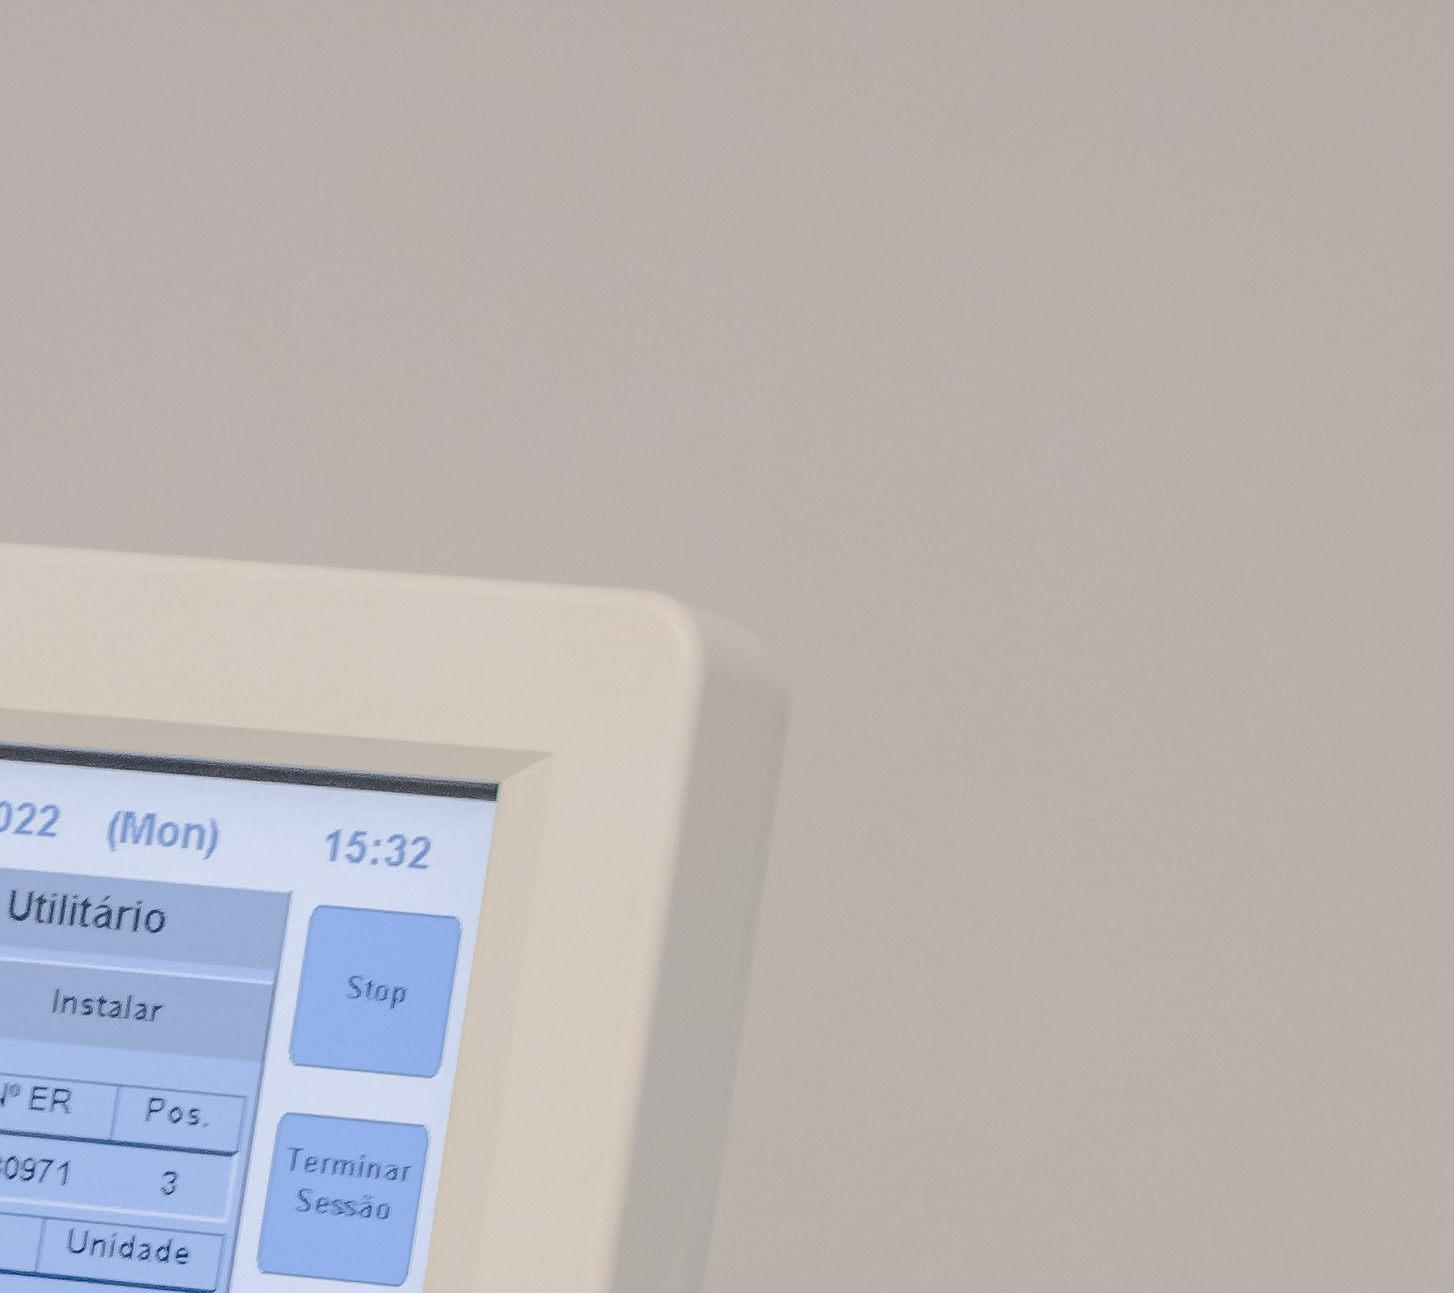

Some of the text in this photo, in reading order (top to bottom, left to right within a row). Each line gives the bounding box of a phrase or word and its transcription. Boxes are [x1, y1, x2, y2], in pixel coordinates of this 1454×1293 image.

[105, 808, 221, 861] (Mon)
[323, 828, 433, 872] 15:32
[8, 888, 168, 936] Utilitário
[51, 986, 165, 1025] Instalar
[344, 974, 409, 1011] Stop
[28, 1085, 74, 1116] ER
[144, 1095, 211, 1129] Pos.
[158, 1169, 180, 1197] 3
[285, 1145, 414, 1184] Terminar
[294, 1186, 394, 1223] Sessão
[65, 1227, 193, 1266] Unidade
